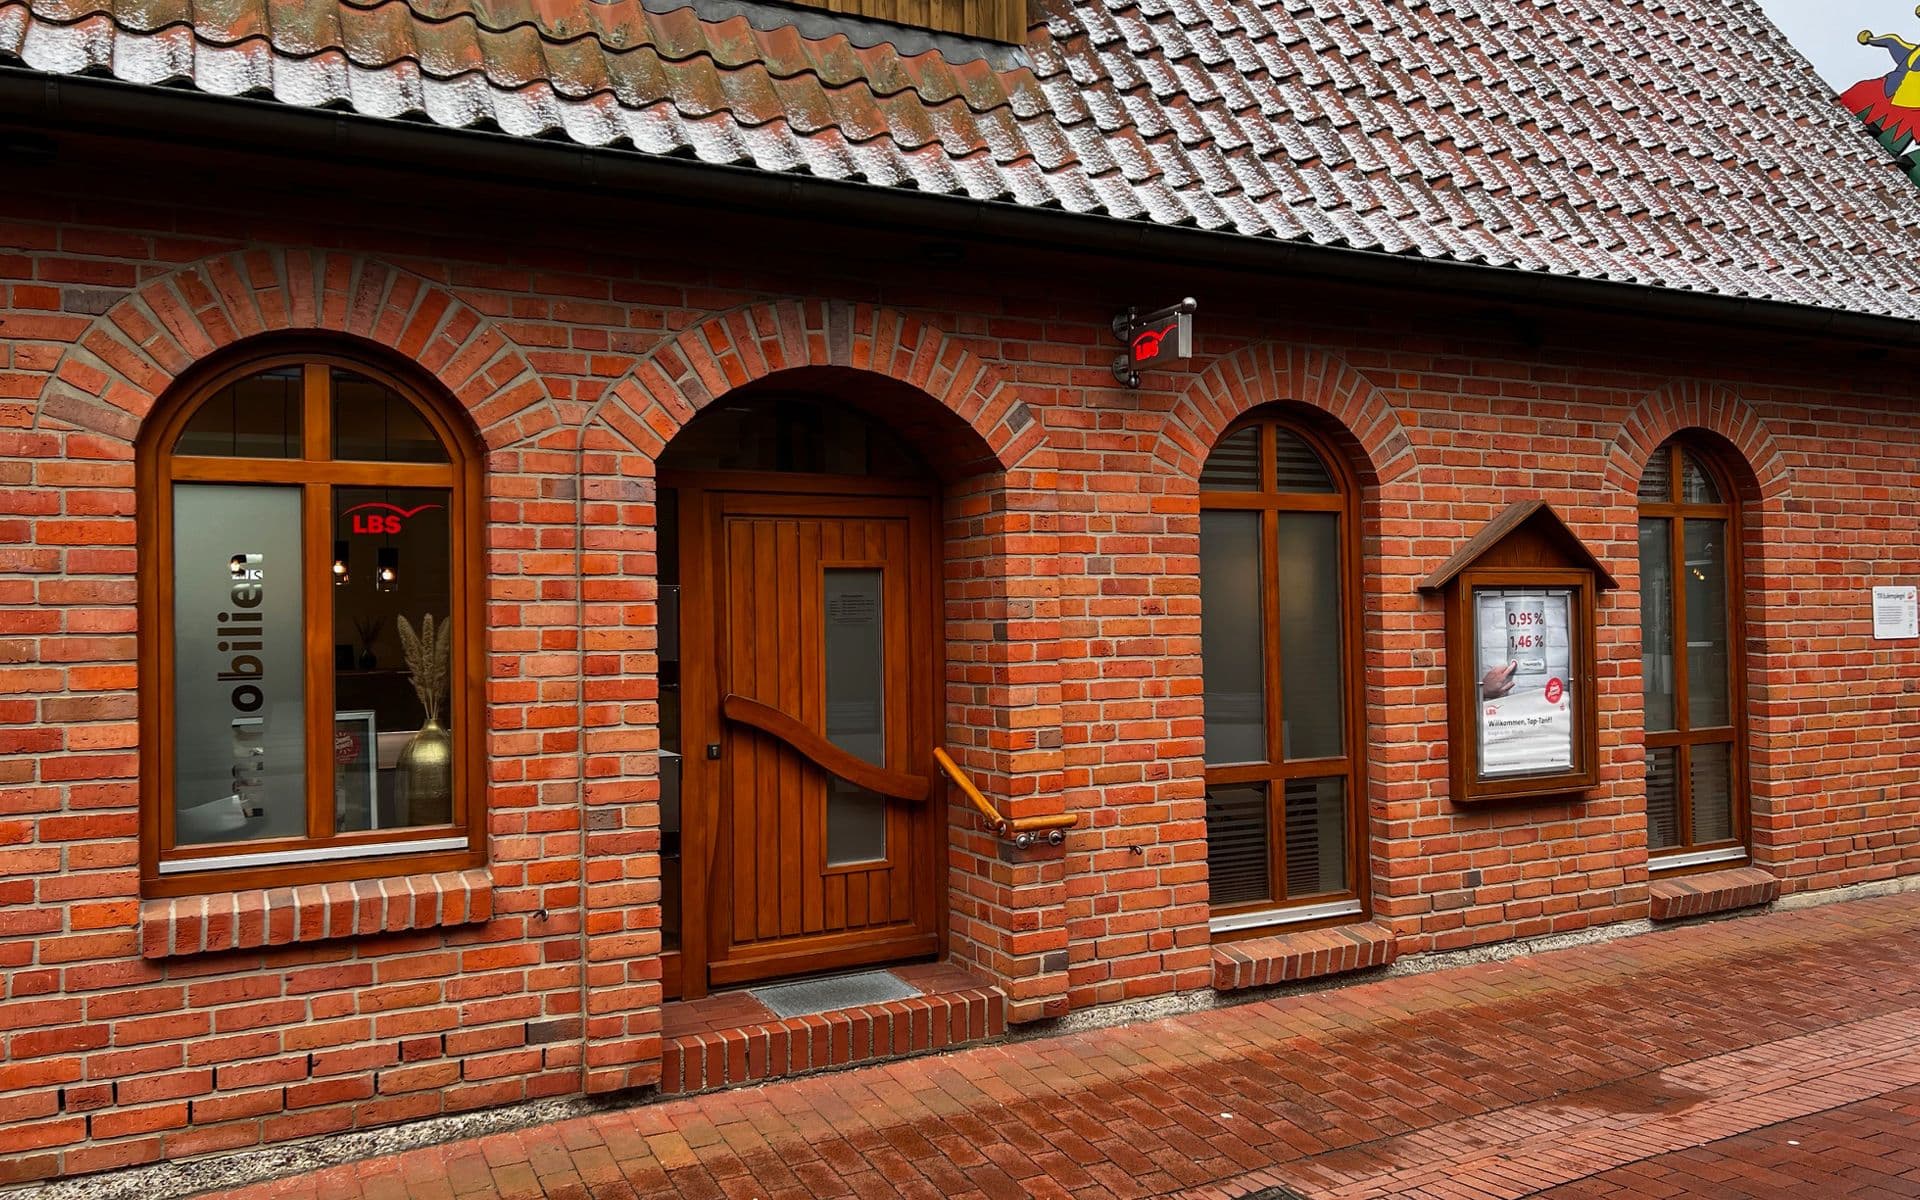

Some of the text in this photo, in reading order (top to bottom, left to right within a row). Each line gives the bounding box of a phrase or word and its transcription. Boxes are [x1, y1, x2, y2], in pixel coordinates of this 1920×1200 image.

[353, 515, 401, 534] LBS
[1508, 612, 1544, 627] 0,95 %
[1510, 635, 1544, 650] 1,46 %
